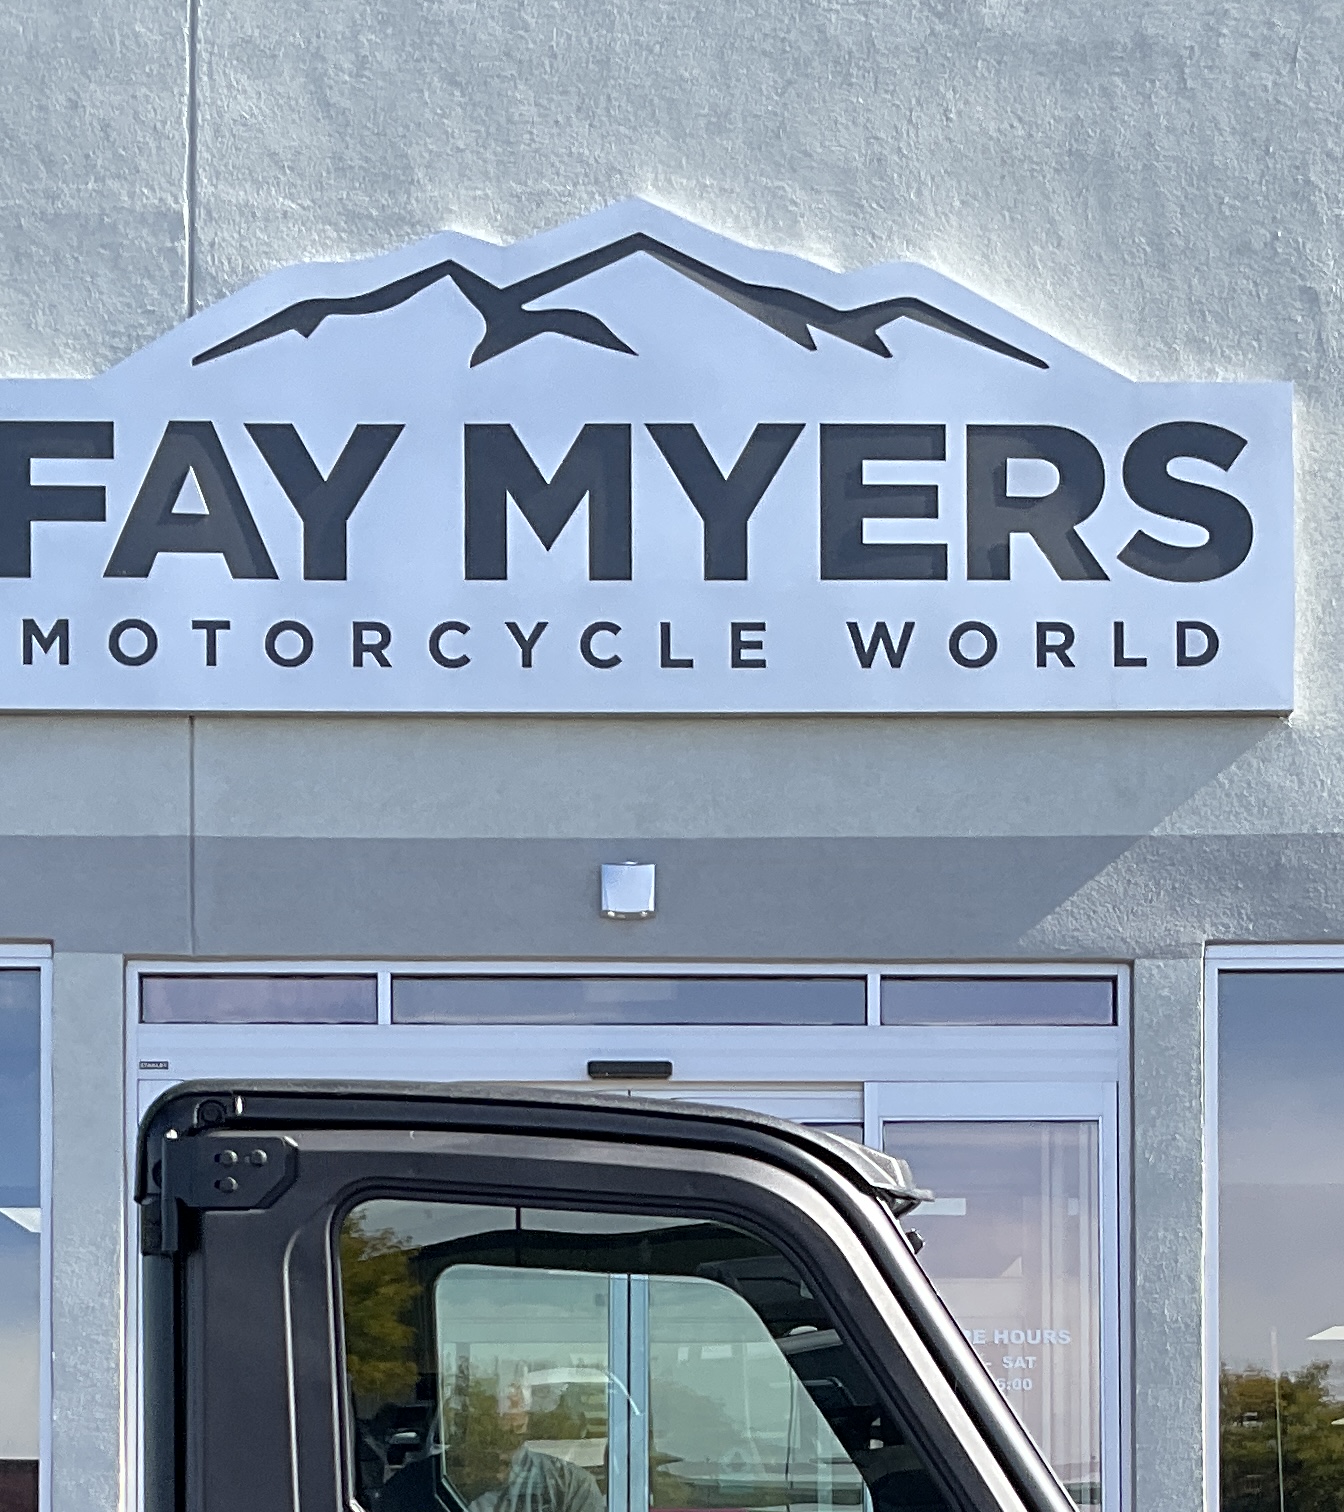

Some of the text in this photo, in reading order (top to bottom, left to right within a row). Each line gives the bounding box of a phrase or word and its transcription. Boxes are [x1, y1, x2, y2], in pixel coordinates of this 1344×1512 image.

[463, 420, 1254, 583] MYERS
[22, 618, 1220, 669] MOTORCYCLE WORLD
[994, 1329, 1071, 1345] HOURS
[1002, 1356, 1037, 1369] SAT
